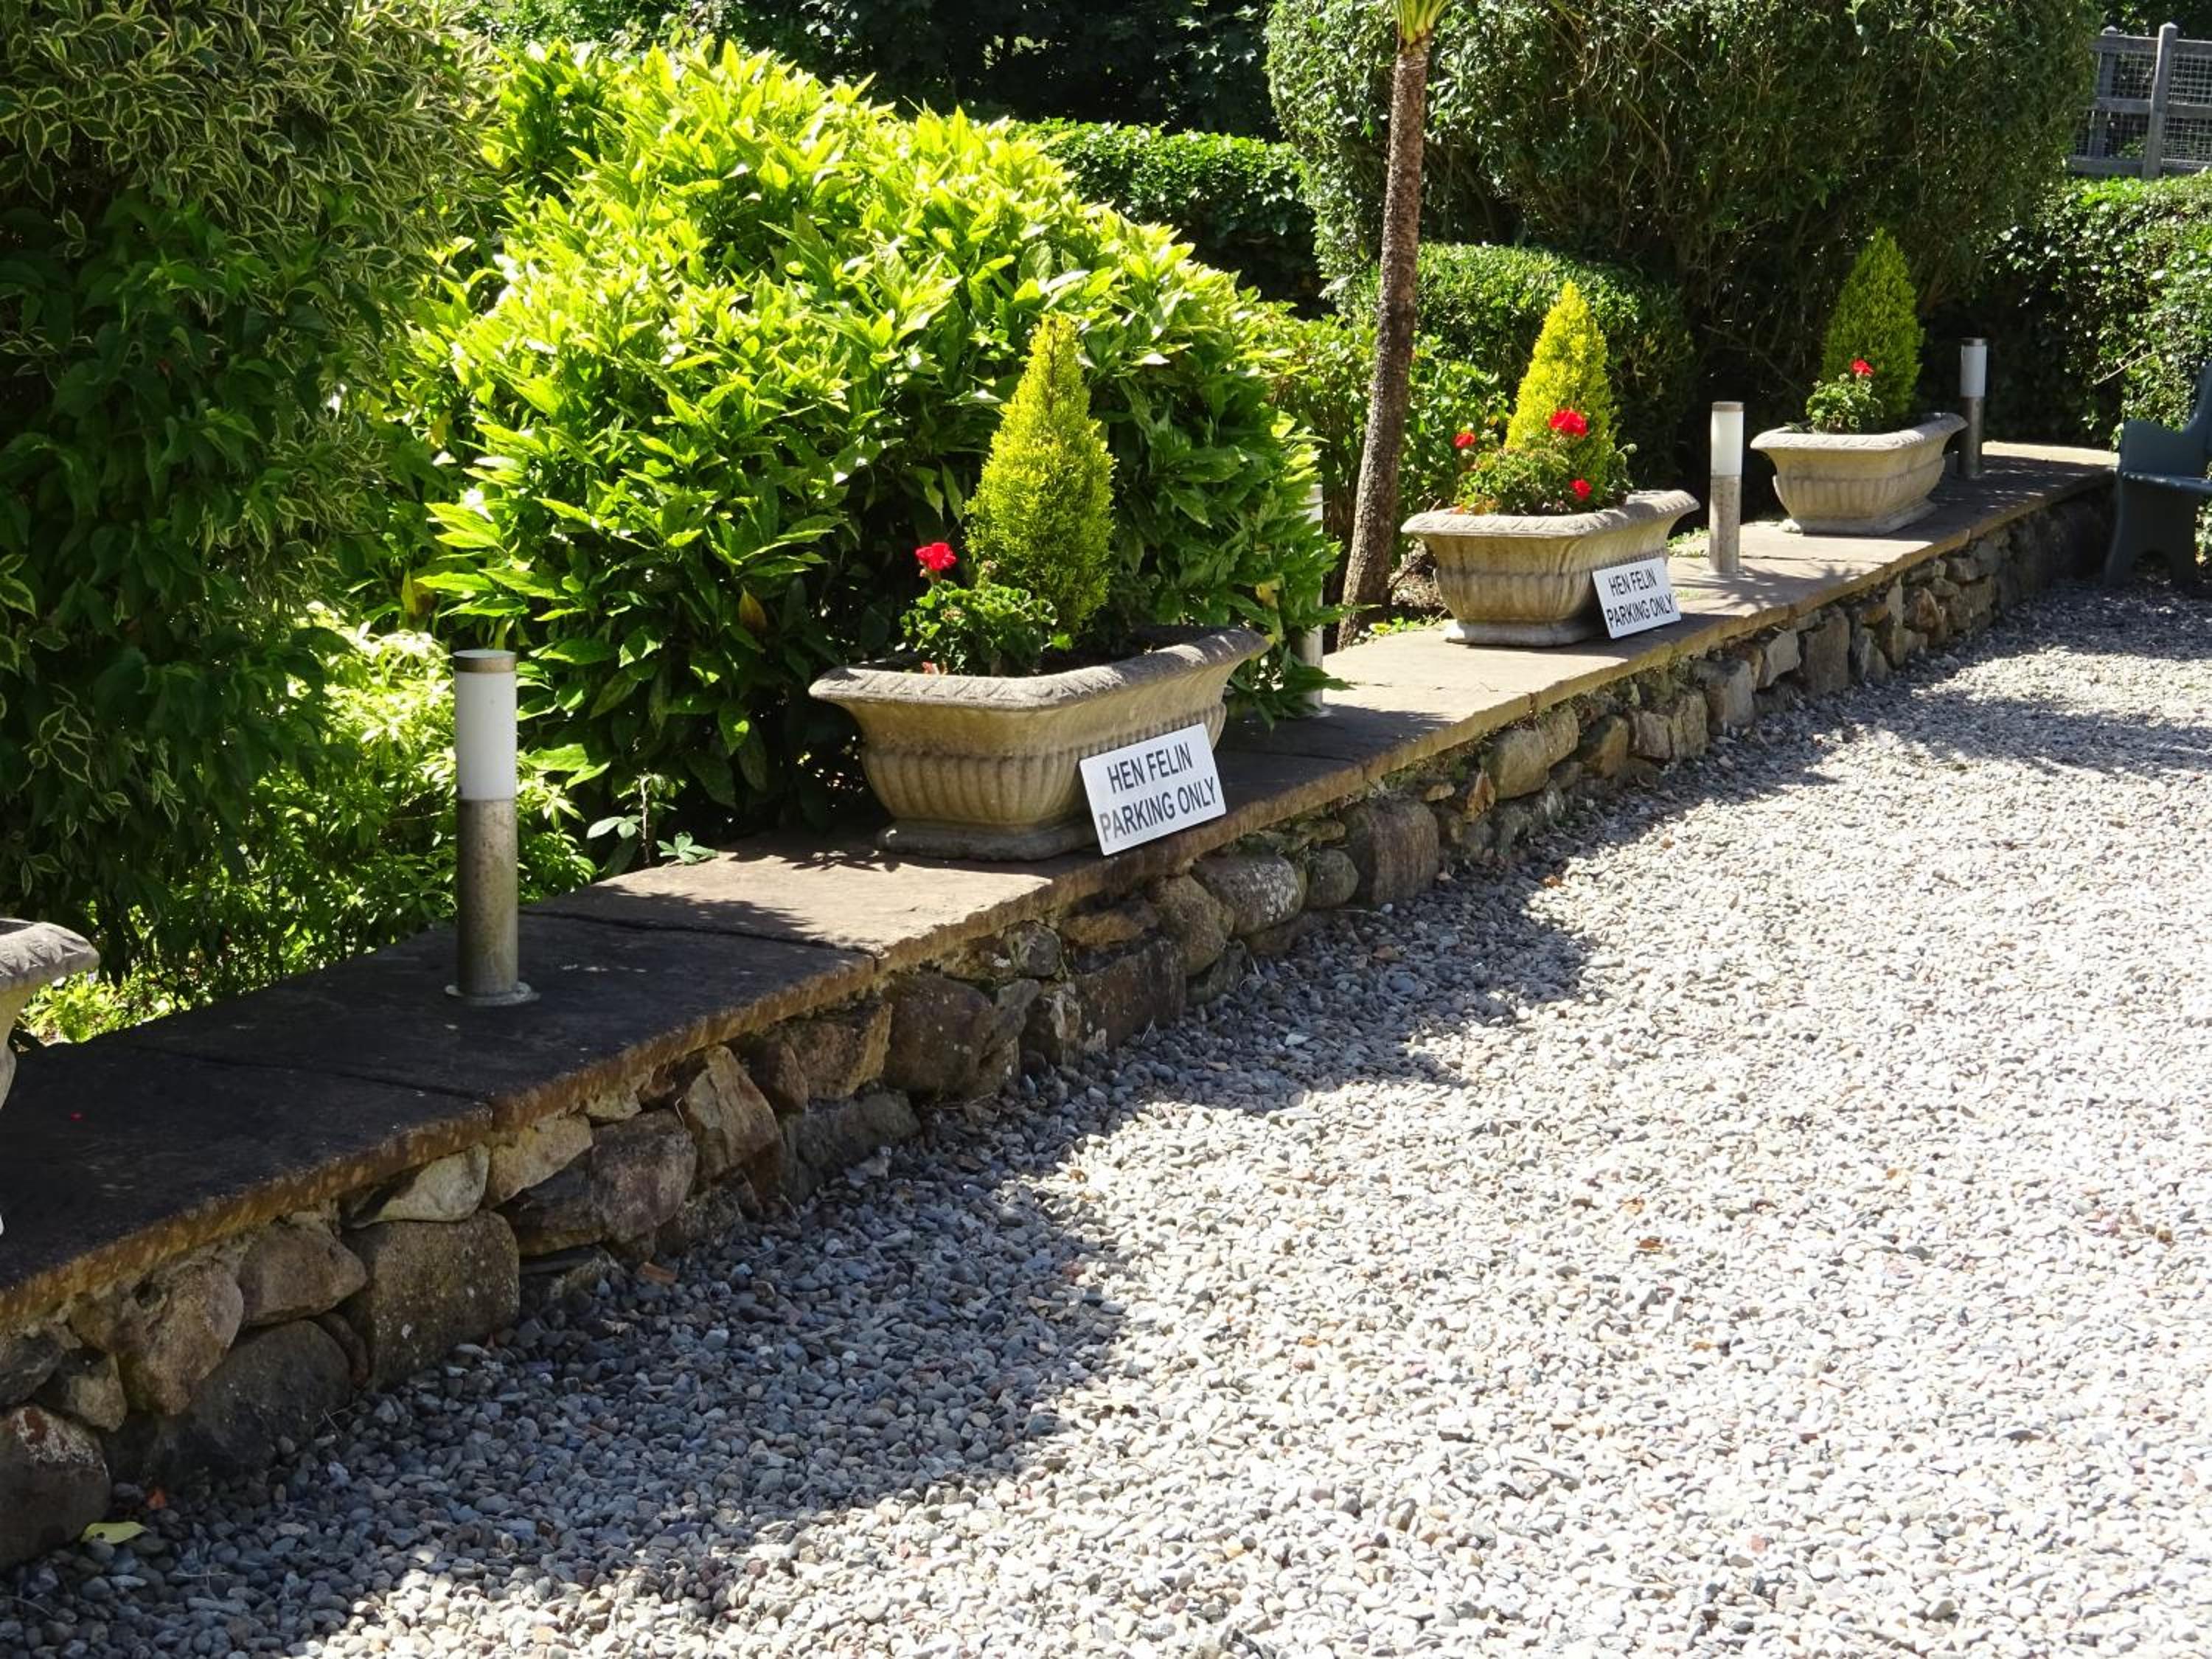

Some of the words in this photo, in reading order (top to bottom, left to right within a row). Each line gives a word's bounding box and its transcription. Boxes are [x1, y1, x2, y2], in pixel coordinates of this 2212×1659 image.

[1608, 572, 1632, 597] HEN
[1629, 567, 1657, 591] FELIN
[1607, 599, 1650, 629] PARKING
[1649, 593, 1674, 617] ONLY
[1107, 757, 1146, 793] HEN
[1146, 742, 1193, 781] FELIN
[1099, 791, 1175, 843] PARKING
[1178, 776, 1217, 814] ONLY
